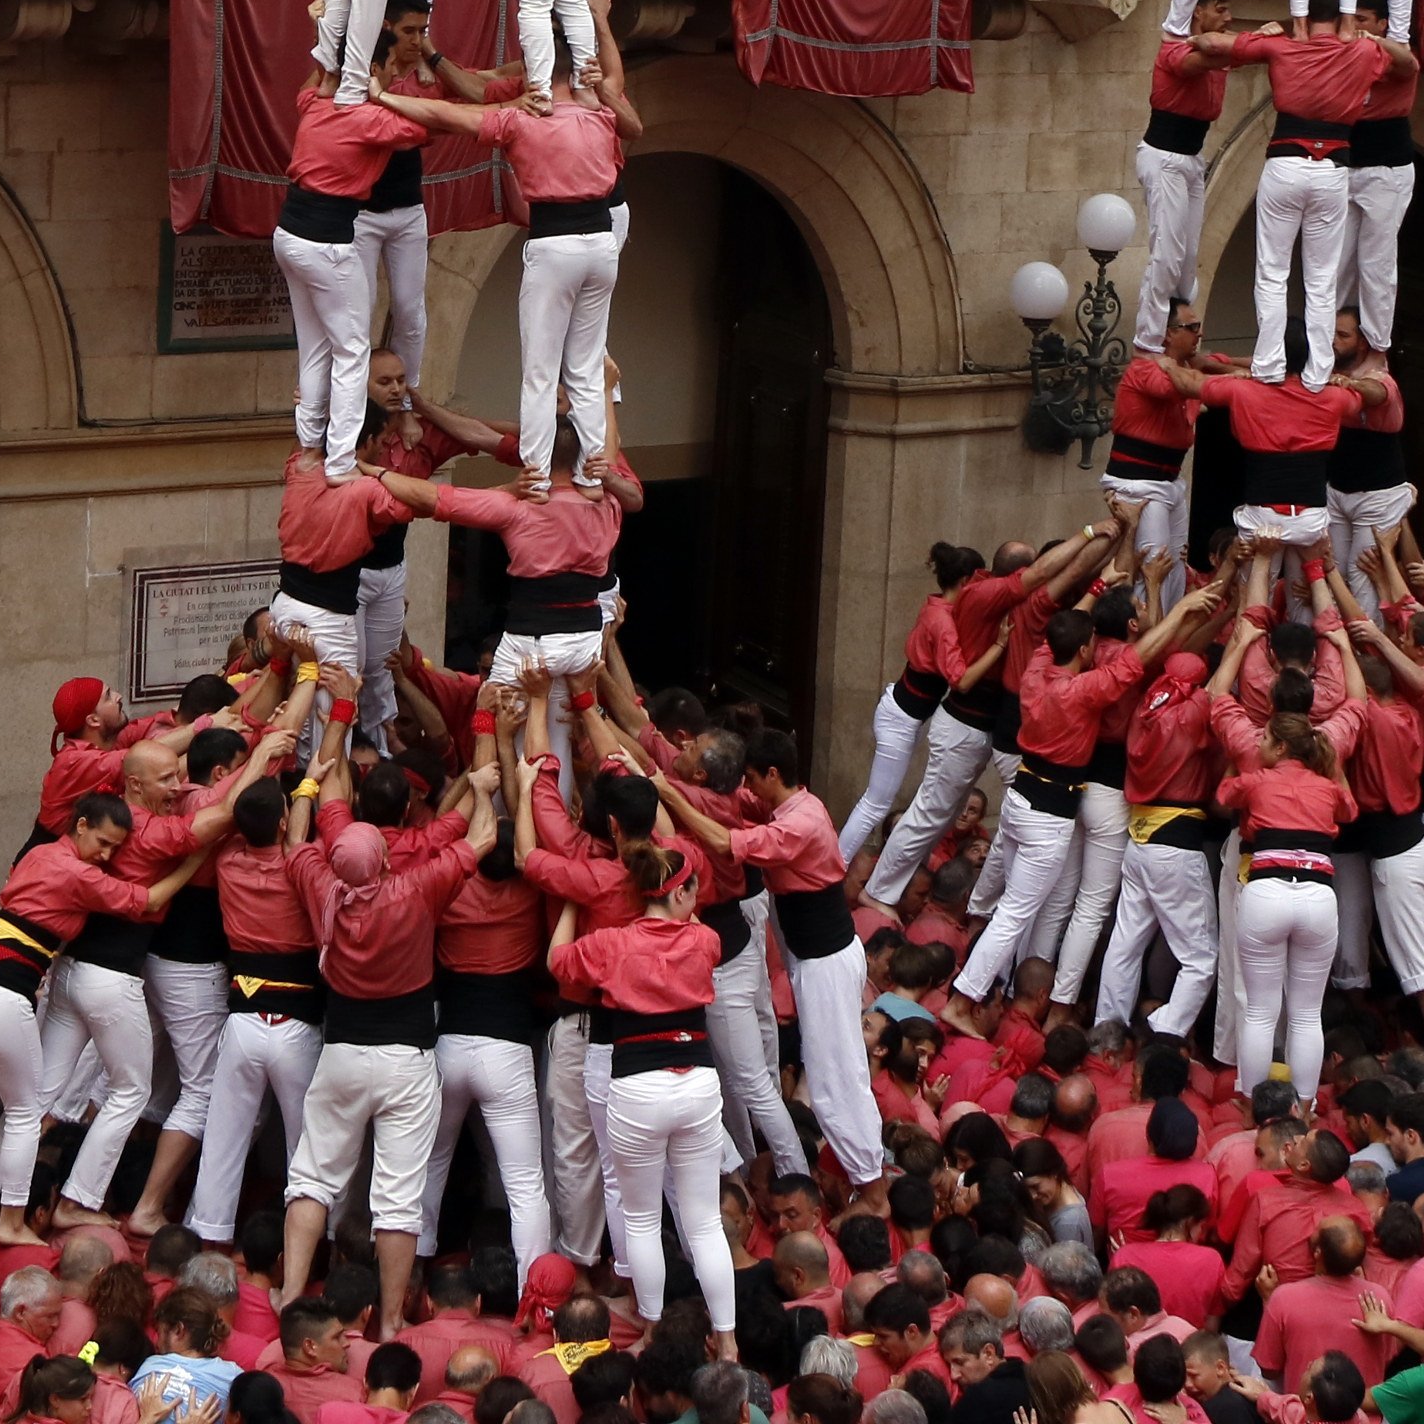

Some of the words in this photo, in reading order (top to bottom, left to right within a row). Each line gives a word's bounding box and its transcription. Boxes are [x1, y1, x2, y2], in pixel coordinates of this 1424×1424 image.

[153, 589, 164, 598] LA
[166, 587, 193, 597] CIUTAT
[201, 585, 218, 594] ELS
[221, 581, 258, 594] XIQUETS
[259, 581, 270, 590] DE
